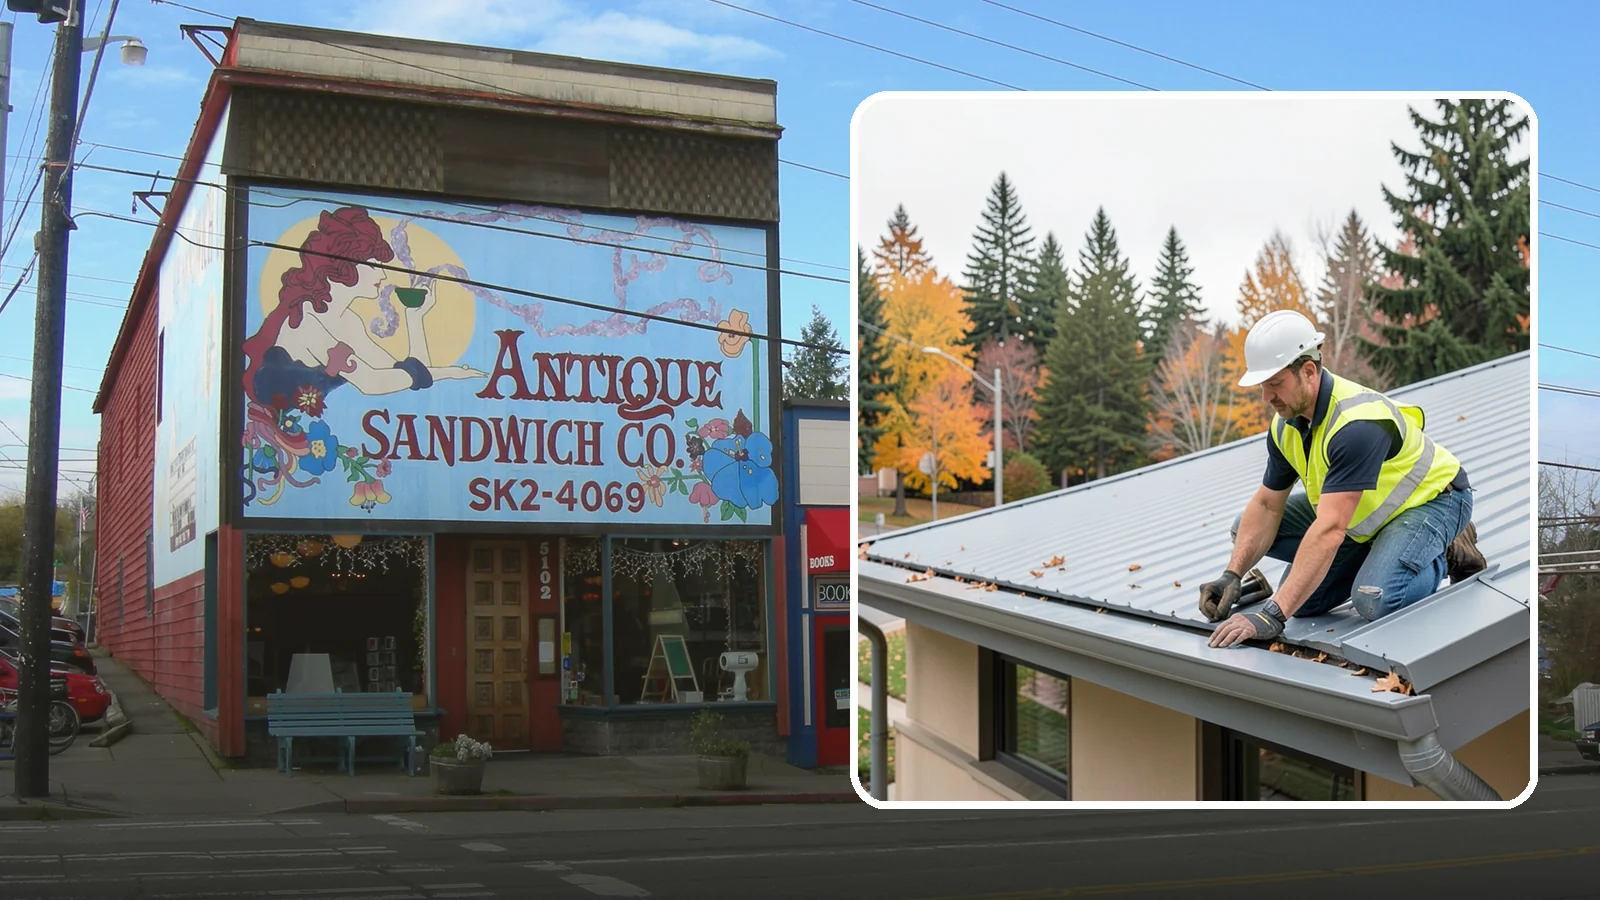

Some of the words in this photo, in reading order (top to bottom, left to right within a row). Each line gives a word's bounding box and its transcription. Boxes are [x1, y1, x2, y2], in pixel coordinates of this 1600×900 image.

[476, 329, 723, 420] ANTIQUE
[362, 409, 604, 466] SANDWICH
[618, 422, 684, 468] CO.
[468, 477, 645, 512] SK2-4069
[540, 541, 551, 599] 5102
[809, 555, 834, 569] BOOKS
